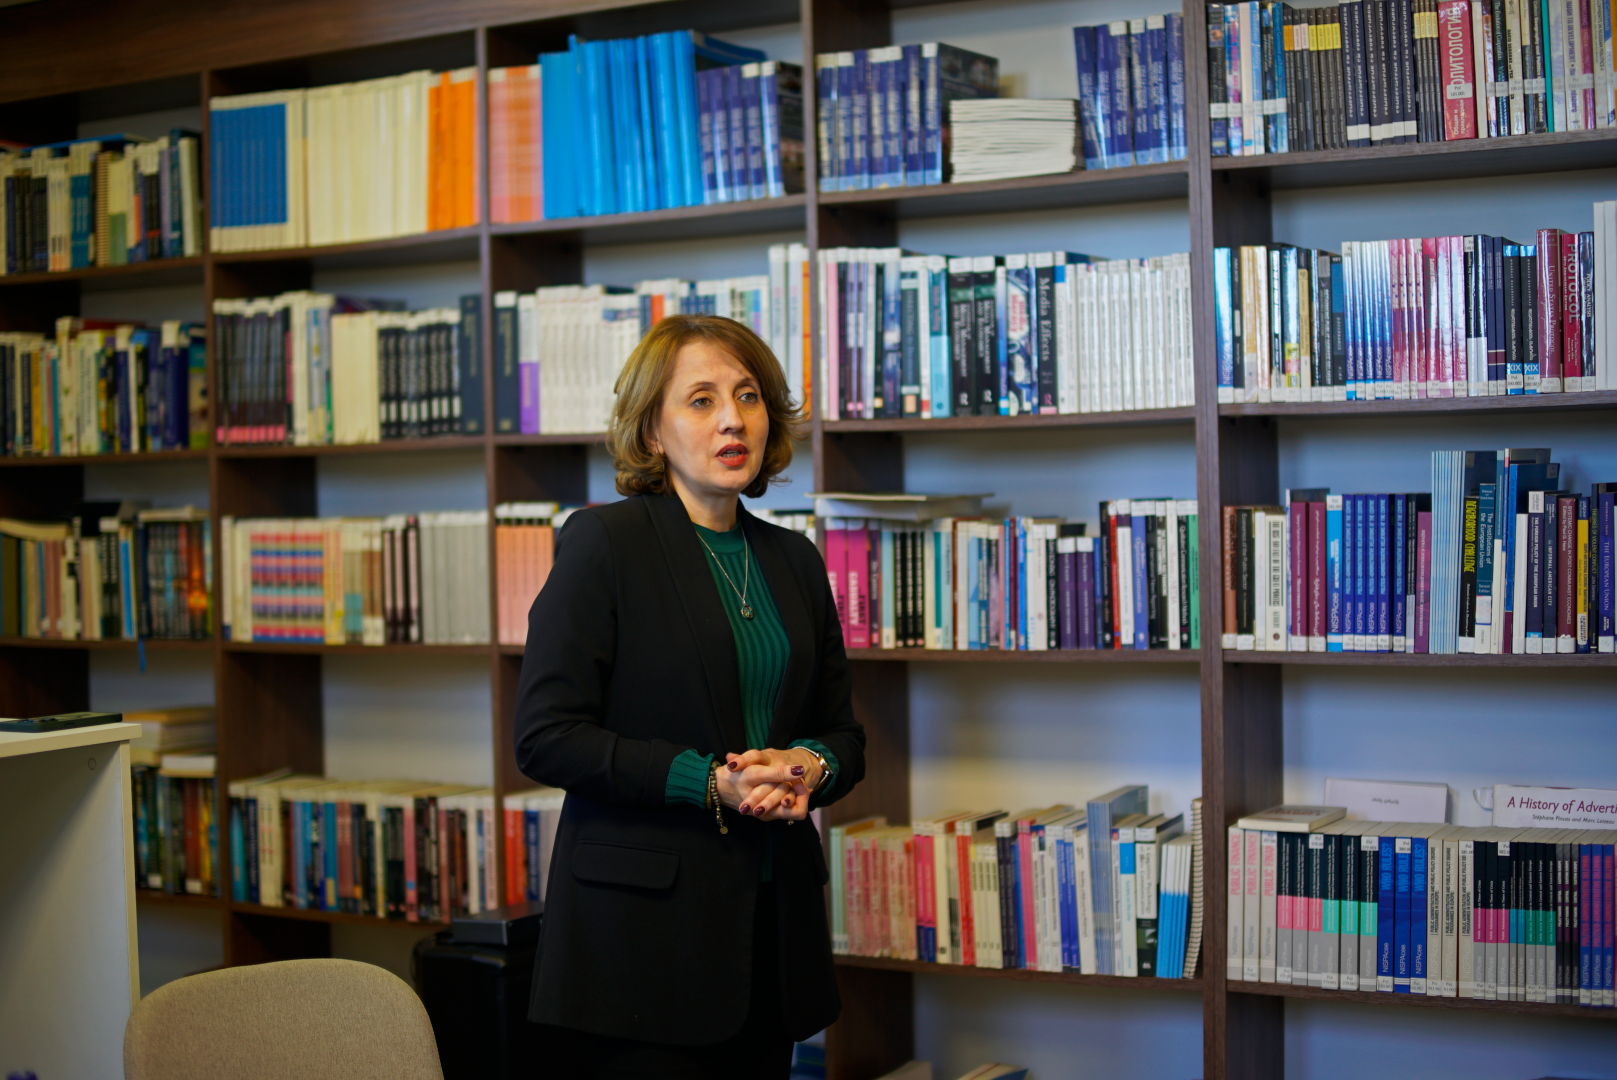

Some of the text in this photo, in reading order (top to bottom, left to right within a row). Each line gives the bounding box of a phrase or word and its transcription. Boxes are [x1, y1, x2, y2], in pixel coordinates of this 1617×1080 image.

[1446, 8, 1465, 86] ОЛИТОЛОГИЯ
[1548, 265, 1556, 292] UNITED
[1567, 243, 1580, 324] PROTOCOL
[1039, 277, 1052, 361] Media Effects
[1507, 364, 1522, 373] XIX
[1524, 364, 1538, 373] XIX
[1463, 500, 1478, 573] NEIGHBORHOOD CHALLENGE
[1478, 522, 1486, 550] European
[1486, 513, 1494, 523] The
[848, 570, 860, 626] CASUALTY
[1331, 592, 1340, 633] NISPAcee
[1507, 796, 1515, 808] A
[1519, 796, 1560, 814] History
[1562, 799, 1576, 814] of
[1230, 833, 1241, 896] PUBLIC FINANCE
[1246, 833, 1258, 896] PUBLIC FINANCE
[1264, 845, 1274, 896] PUBLIC FINAN
[1381, 842, 1392, 890] WHO RULES?
[1398, 853, 1409, 892] WHO RULE
[1414, 844, 1426, 892] WHO RULES?
[1582, 855, 1590, 947] POLITICO-ADMINISTRATIVE DILEMMA
[1593, 855, 1601, 947] POLITICO-ADMINISTRATIVE DILEMMA
